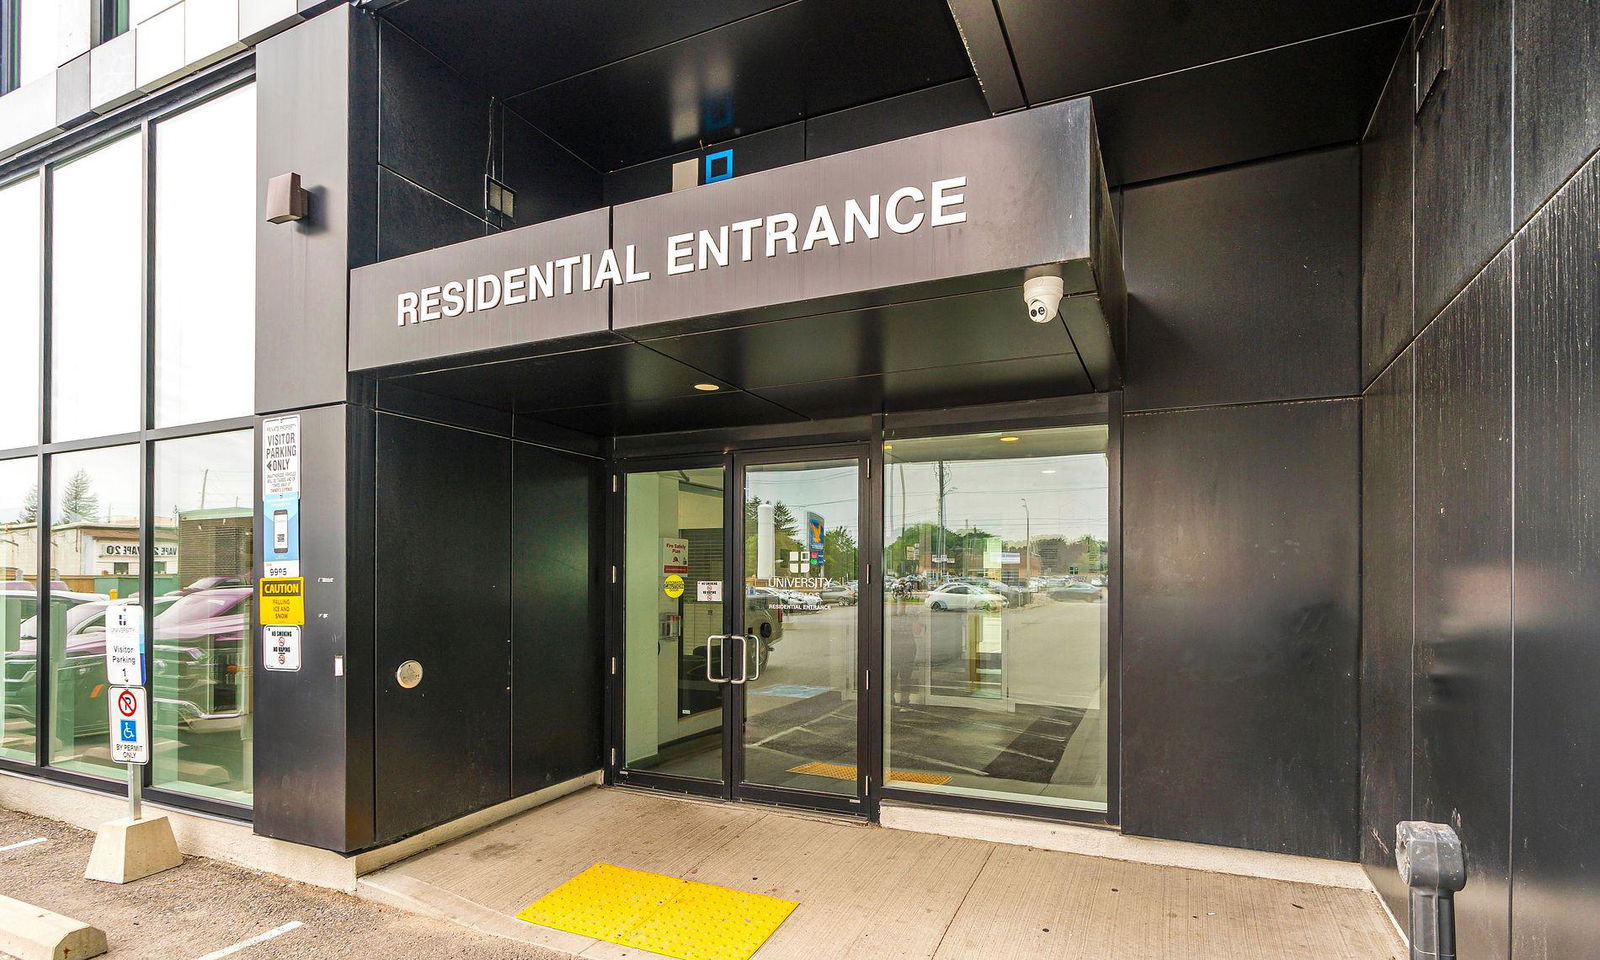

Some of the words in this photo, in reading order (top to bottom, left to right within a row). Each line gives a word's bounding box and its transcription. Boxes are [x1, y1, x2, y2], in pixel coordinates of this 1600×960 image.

[397, 245, 651, 327] RESIDENTIAL
[667, 175, 968, 276] ENTRANCE
[268, 432, 296, 447] VISITOR
[266, 445, 297, 459] PARKING
[273, 458, 290, 471] ONLY
[768, 577, 833, 588] UNIVERSITY
[264, 583, 299, 594] CAUTION
[113, 645, 134, 653] Visitor
[112, 655, 136, 665] Parking
[122, 668, 127, 677] 1
[124, 744, 143, 752] PERMIT
